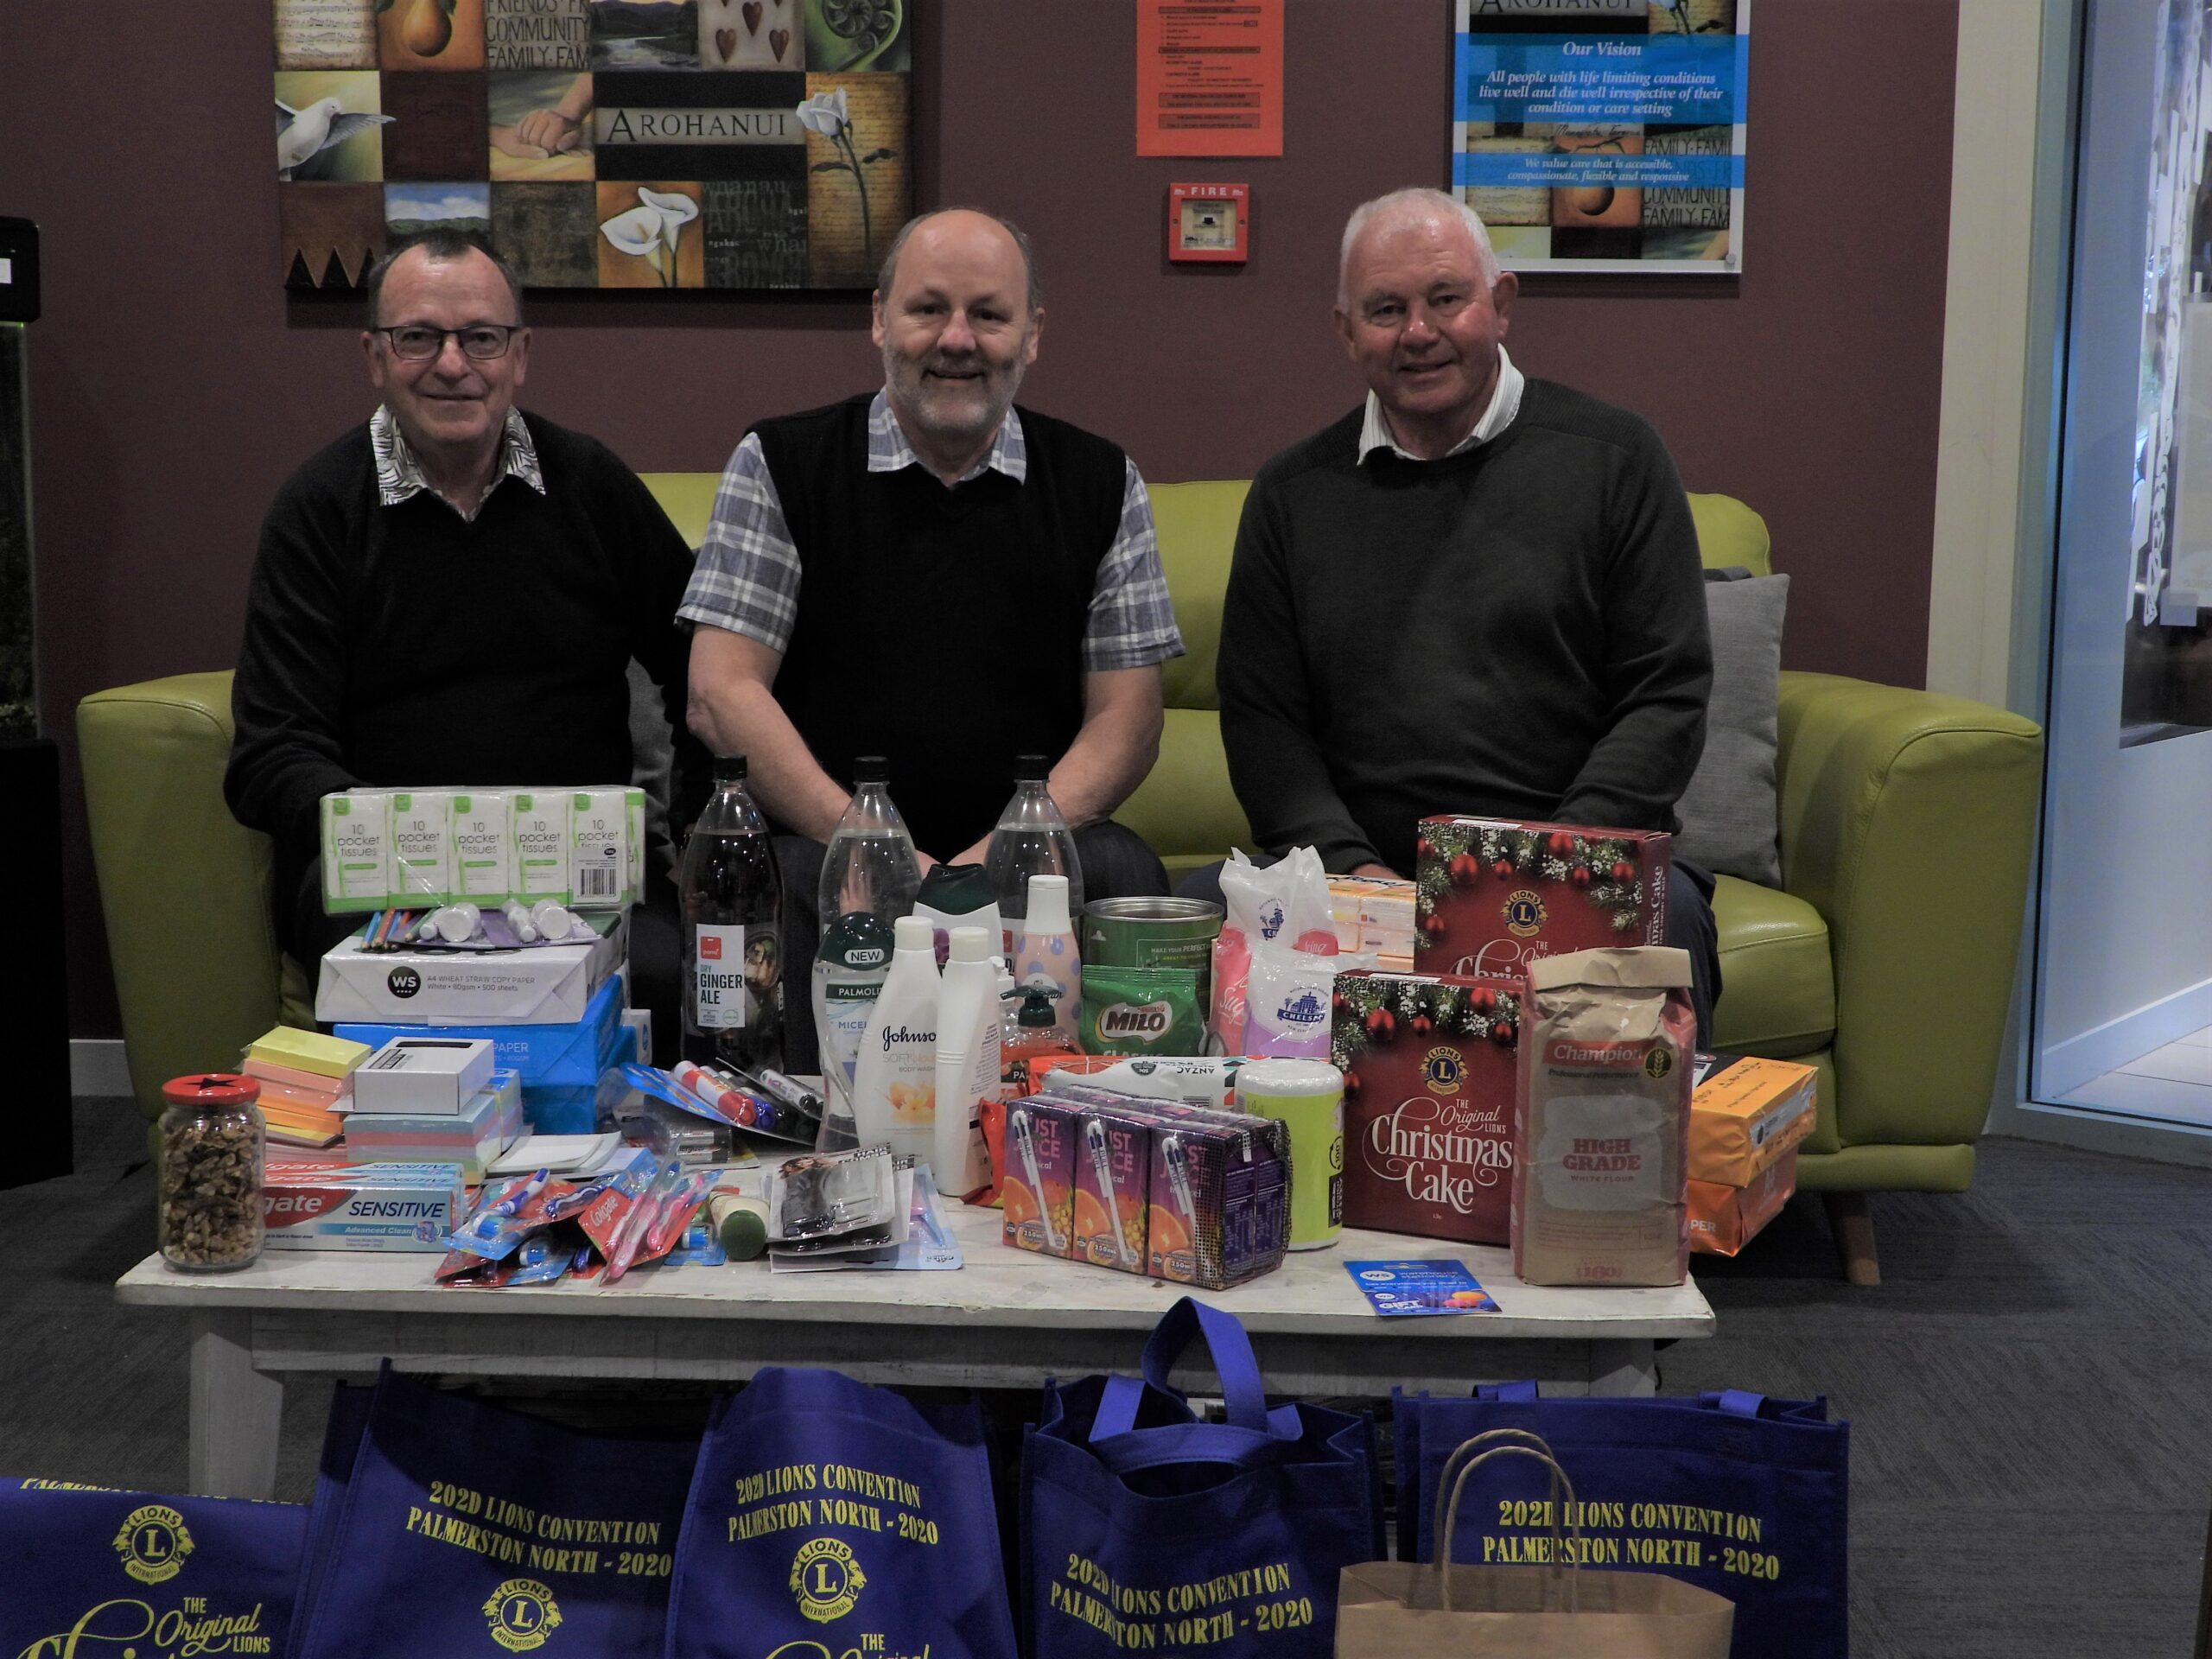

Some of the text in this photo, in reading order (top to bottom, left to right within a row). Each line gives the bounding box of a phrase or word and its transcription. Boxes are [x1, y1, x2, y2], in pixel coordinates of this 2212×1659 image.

[486, 16, 589, 41] COMMUNITY
[1562, 41, 1642, 56] Our Vision
[1487, 71, 1716, 87] All people with life limiting conditions
[1479, 85, 1723, 102] live well and die well irrespective of their
[1529, 101, 1673, 117] condition or care setting
[607, 109, 786, 143] AROHANUI
[1525, 159, 1540, 168] We
[1542, 158, 1567, 168] value
[1592, 159, 1612, 168] that
[1615, 159, 1624, 168] is
[1508, 170, 1689, 183] compassionate, flexible and responsive
[1192, 187, 1227, 196] FIRE
[352, 824, 365, 835] 10
[413, 821, 425, 830] 10
[474, 823, 486, 832] 10
[534, 821, 546, 831] 10
[592, 820, 605, 830] 10
[338, 836, 379, 847] pocket
[398, 831, 440, 843] pocket
[459, 833, 500, 844] pocket
[519, 833, 560, 844] pocket
[578, 831, 619, 842] pocket
[340, 847, 378, 856] tissues
[402, 843, 437, 854] tissues
[461, 844, 497, 855] tissues
[522, 843, 558, 853] tissues
[1512, 891, 1539, 903] LIONS
[1519, 904, 1531, 922] L
[1535, 940, 1548, 950] THE
[851, 951, 880, 961] NEW
[392, 976, 417, 988] WS
[701, 973, 742, 988] GINGER
[701, 989, 721, 1004] ALE
[838, 987, 882, 996] PALMOLI
[1106, 1011, 1166, 1032] MILO
[882, 1026, 937, 1052] Johnso
[1431, 1048, 1459, 1060] LIONS
[1554, 1045, 1642, 1064] Champion
[1438, 1061, 1452, 1079] L
[1456, 1098, 1469, 1109] THE
[1440, 1105, 1501, 1133] Original
[1370, 1097, 1512, 1171] Christmas
[1484, 1124, 1507, 1135] LIONS
[1573, 1138, 1631, 1154] HIGH
[1562, 1154, 1641, 1171] GRADE
[1404, 1160, 1474, 1214] Cake
[349, 1201, 446, 1217] SENSITIVE
[590, 1195, 620, 1227] Colgate
[345, 1226, 386, 1235] Advanced
[1690, 1218, 1716, 1232] PER
[1379, 1300, 1421, 1309] GIFT
[766, 1464, 817, 1496] LIONS
[823, 1464, 921, 1510] CONVENTION
[134, 1507, 180, 1525] LIONS
[429, 1480, 662, 1545] 202D LIONS CONVENTION
[728, 1499, 812, 1542] PALMERSTON
[819, 1498, 881, 1532] NORTH
[898, 1512, 939, 1545] 2020
[1563, 1501, 1624, 1529] LIONS
[1630, 1502, 1762, 1543] CONVENTION
[144, 1529, 166, 1557] L
[405, 1507, 527, 1566] PALMERSTON
[528, 1544, 600, 1573] NORTH
[617, 1552, 673, 1577] 2020
[801, 1541, 849, 1559] LIONS
[1482, 1535, 1618, 1564] PALMERSTON
[1626, 1538, 1701, 1567] NORTH
[1724, 1547, 1780, 1580] 2020
[130, 1563, 178, 1580] INTERNATIONAL
[815, 1563, 837, 1593] L
[505, 1580, 550, 1599] LIONS
[1167, 1562, 1291, 1613] CONVENTION
[183, 1597, 207, 1614] THE
[512, 1599, 533, 1628] L
[802, 1600, 850, 1617] INTERNATIONAL
[1050, 1580, 1156, 1649] PALMERTON
[1164, 1610, 1235, 1646] NORTH
[1255, 1597, 1313, 1631] 2020
[155, 1602, 263, 1658] Original
[495, 1629, 542, 1647] INTERNATIONAL
[232, 1636, 270, 1654] LIONS
[860, 1633, 886, 1651] THE
